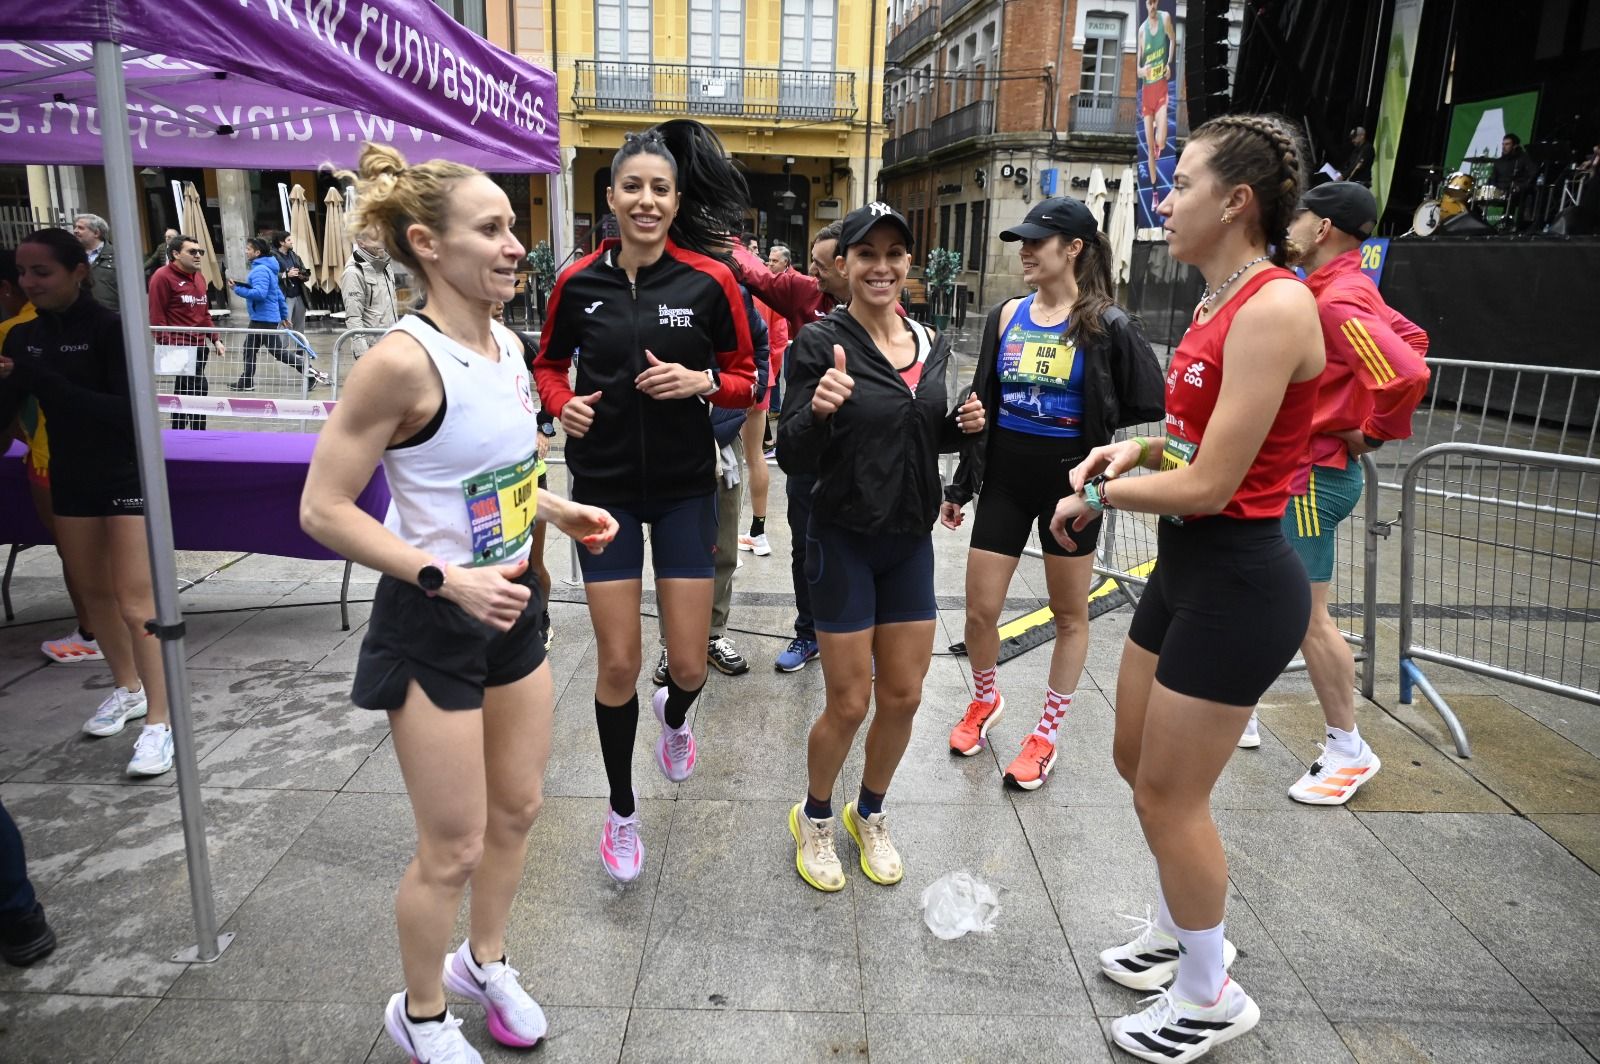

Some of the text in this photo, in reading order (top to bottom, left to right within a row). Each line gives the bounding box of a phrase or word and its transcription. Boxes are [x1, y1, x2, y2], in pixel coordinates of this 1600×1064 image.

[1361, 244, 1382, 269] 26
[658, 308, 694, 317] DESPENSA
[669, 315, 693, 328] FER
[1036, 346, 1057, 359] ALBA
[1035, 360, 1050, 375] 15
